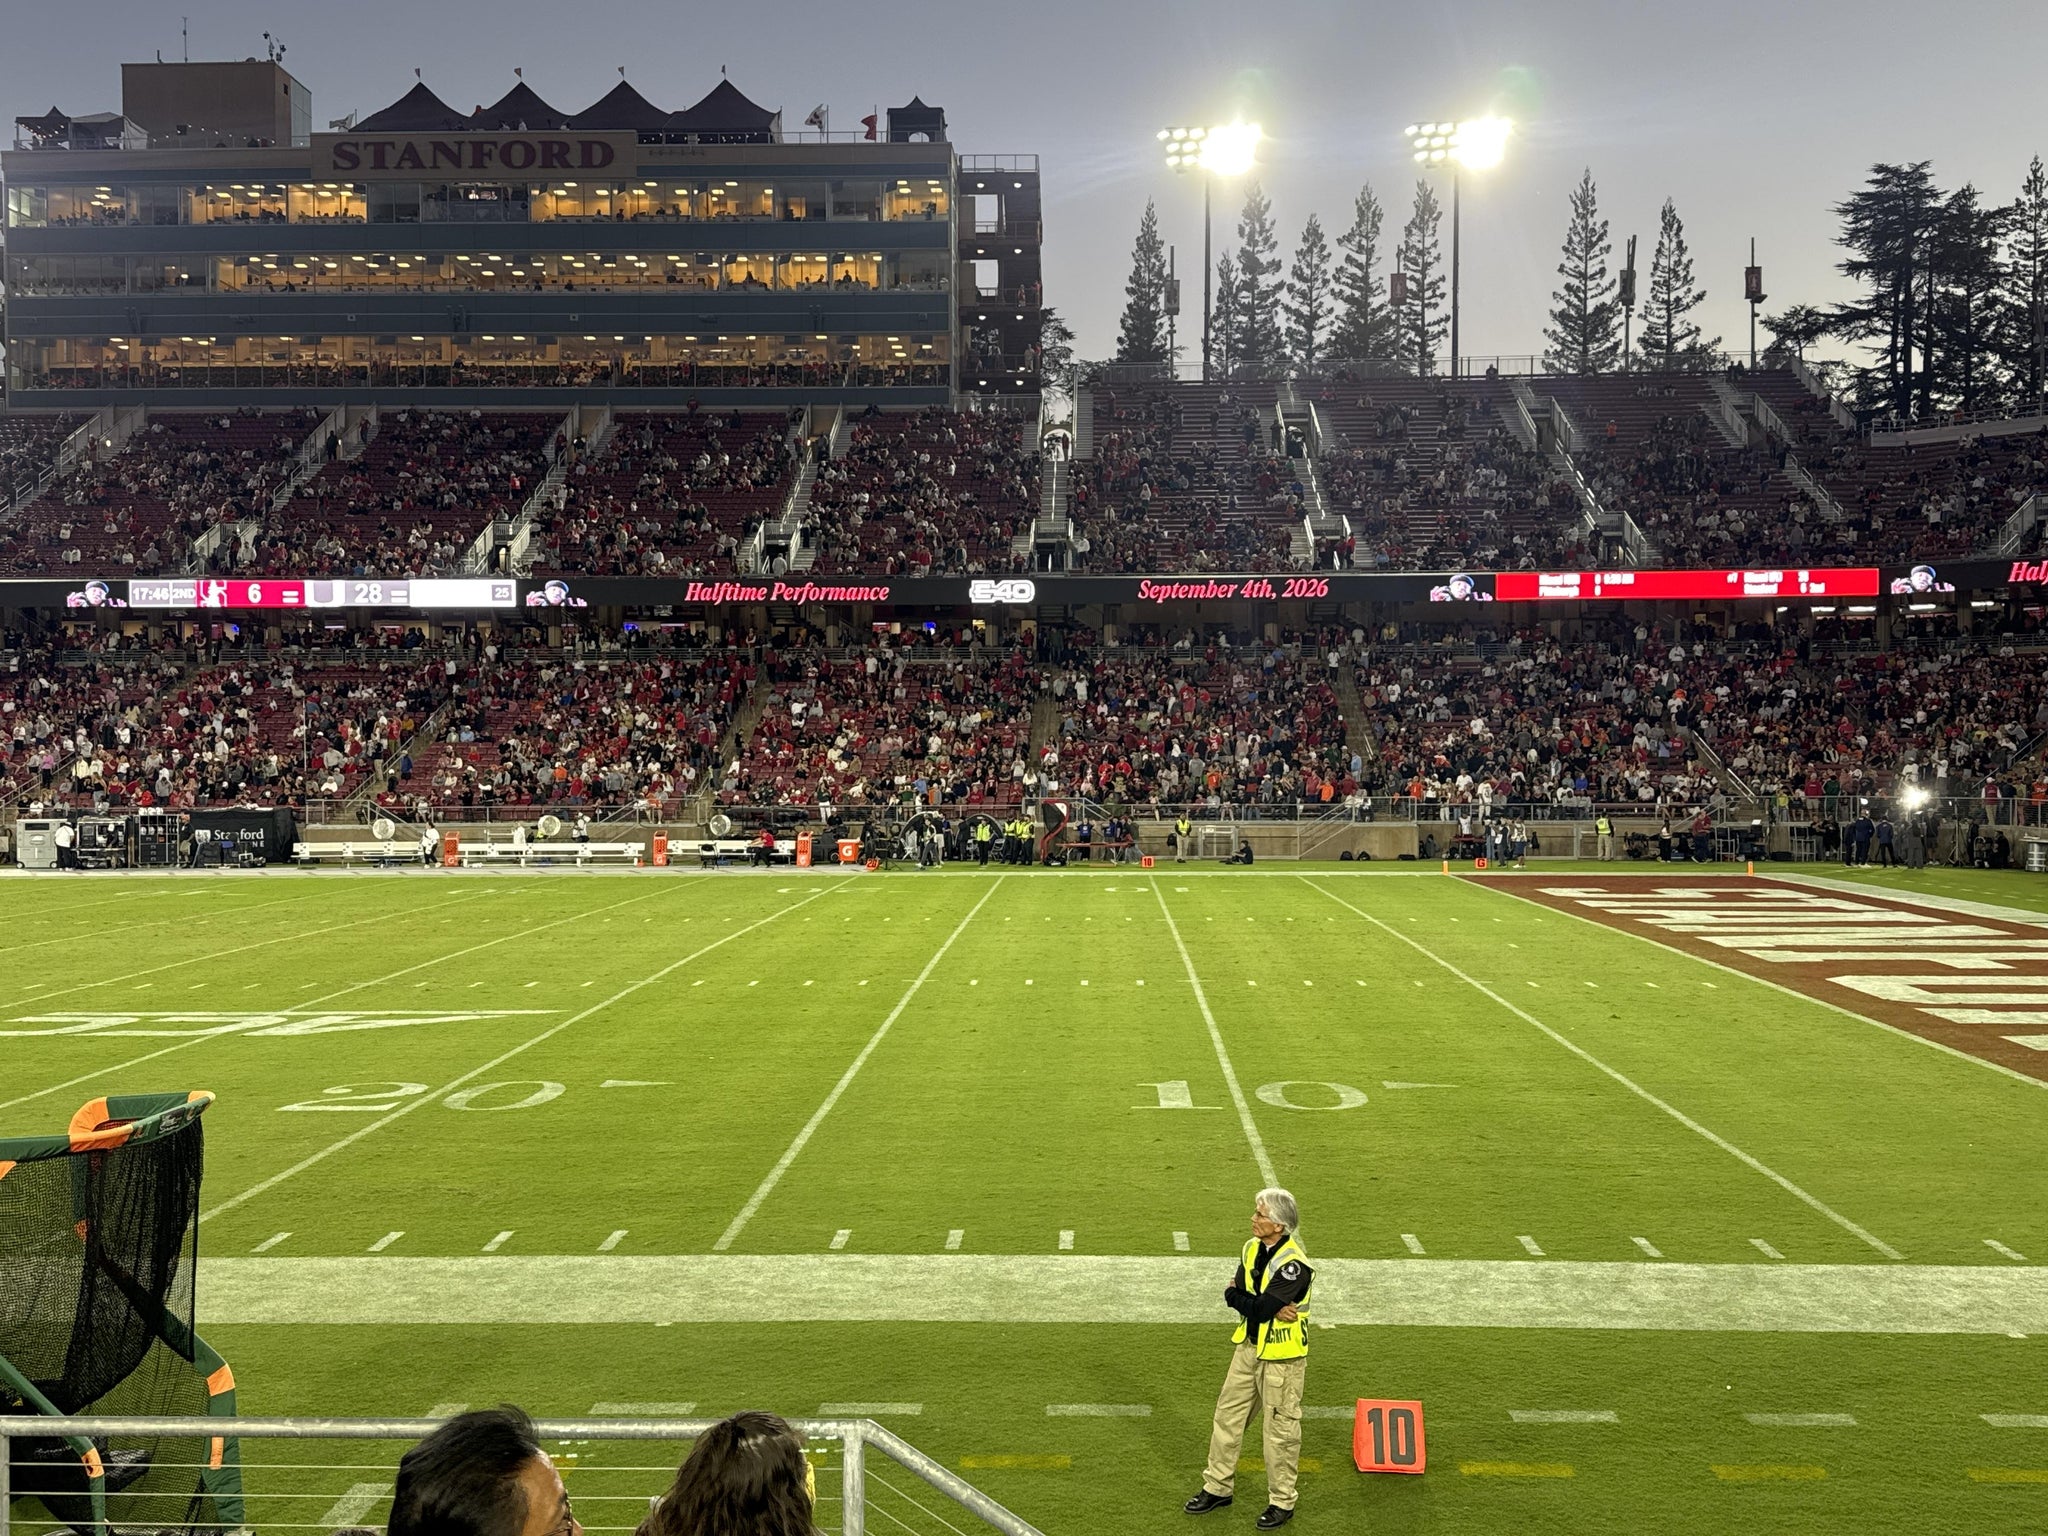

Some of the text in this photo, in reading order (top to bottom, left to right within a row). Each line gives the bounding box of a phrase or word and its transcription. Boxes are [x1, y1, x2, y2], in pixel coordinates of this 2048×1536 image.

[332, 140, 615, 170] STANFORD
[172, 588, 196, 599] 2ND
[248, 583, 262, 603] 6
[354, 583, 383, 604] 28
[494, 587, 510, 599] 25
[685, 581, 890, 605] Halftime Performance
[969, 580, 1035, 603] E-40
[1137, 578, 1330, 603] September 4th, 2026
[214, 828, 264, 841] Staford
[842, 845, 853, 857] G
[1143, 857, 1152, 867] 10
[1477, 858, 1486, 868] G
[276, 1082, 567, 1111] 20
[1131, 1080, 1369, 1110] 10
[1367, 1408, 1416, 1465] 10
